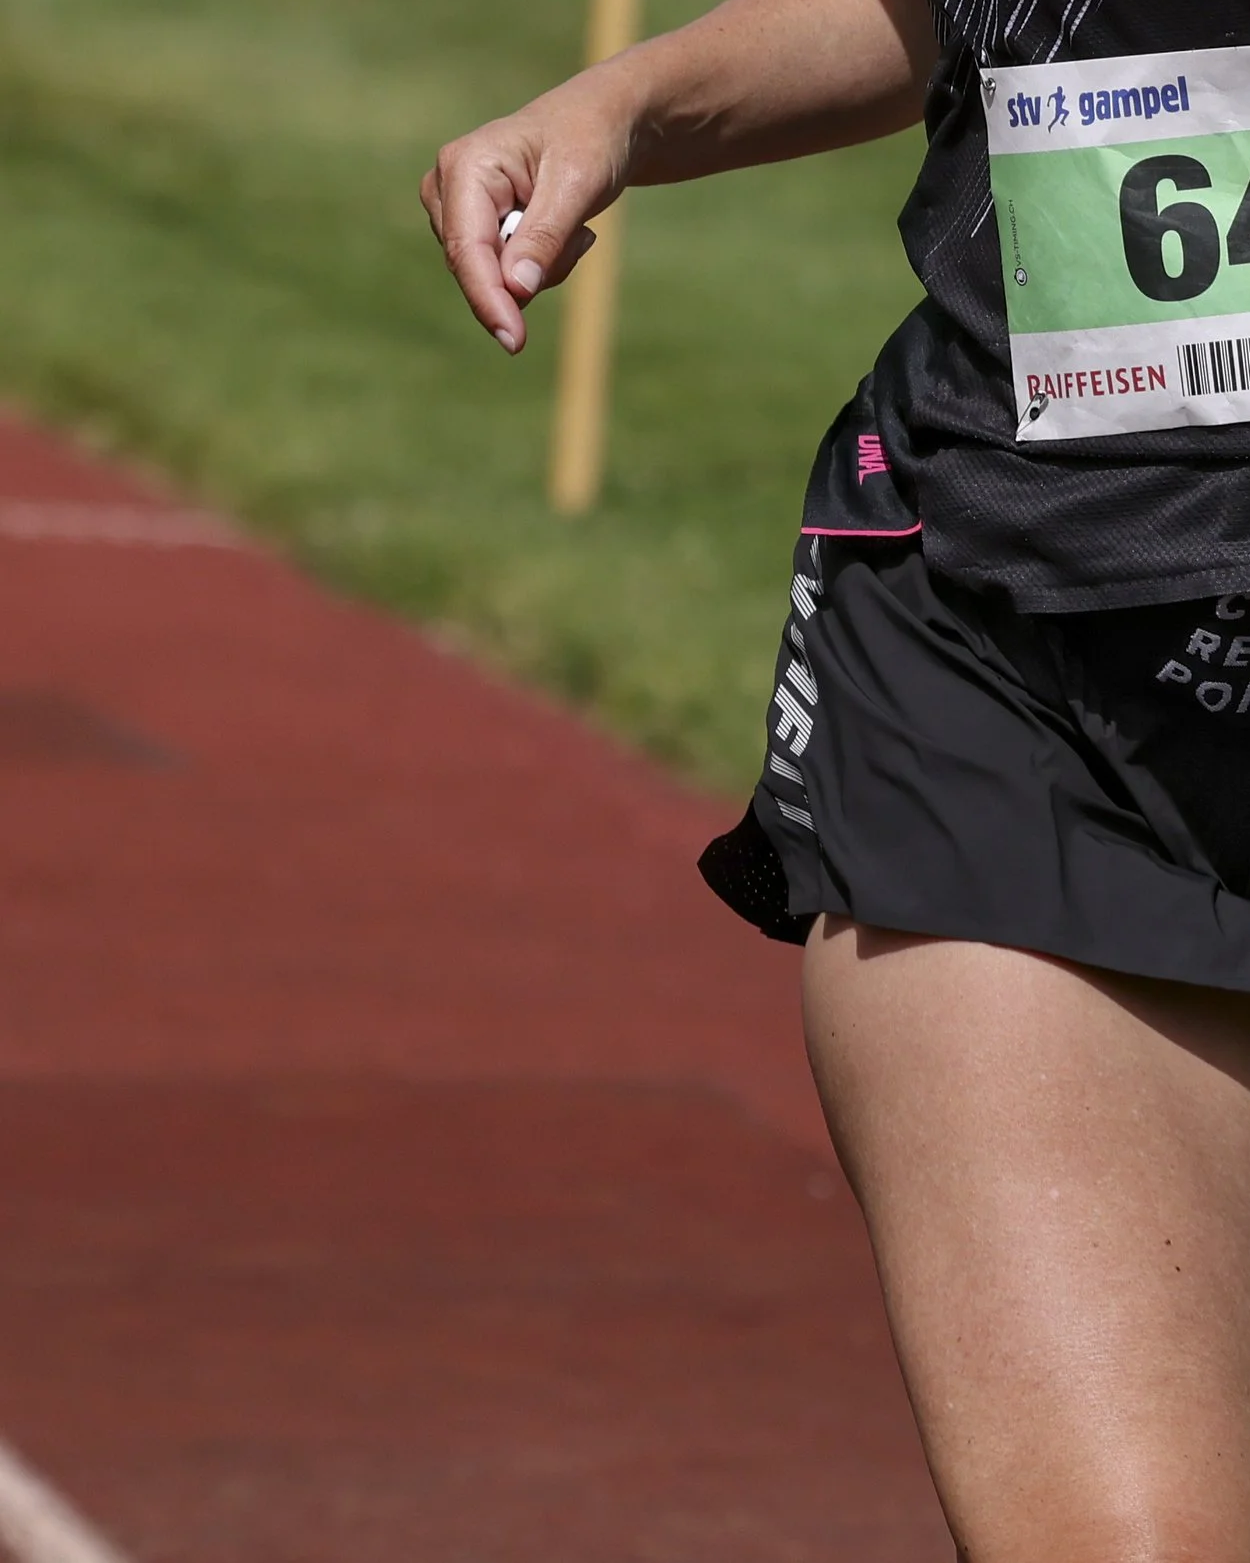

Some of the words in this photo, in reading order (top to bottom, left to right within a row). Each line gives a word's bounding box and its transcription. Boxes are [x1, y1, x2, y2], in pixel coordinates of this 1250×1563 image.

[1007, 92, 1041, 128] stv
[1079, 75, 1190, 126] gampel
[1008, 199, 1021, 267] VS-TIMING.CH
[1026, 364, 1167, 401] RAIFFEISEN
